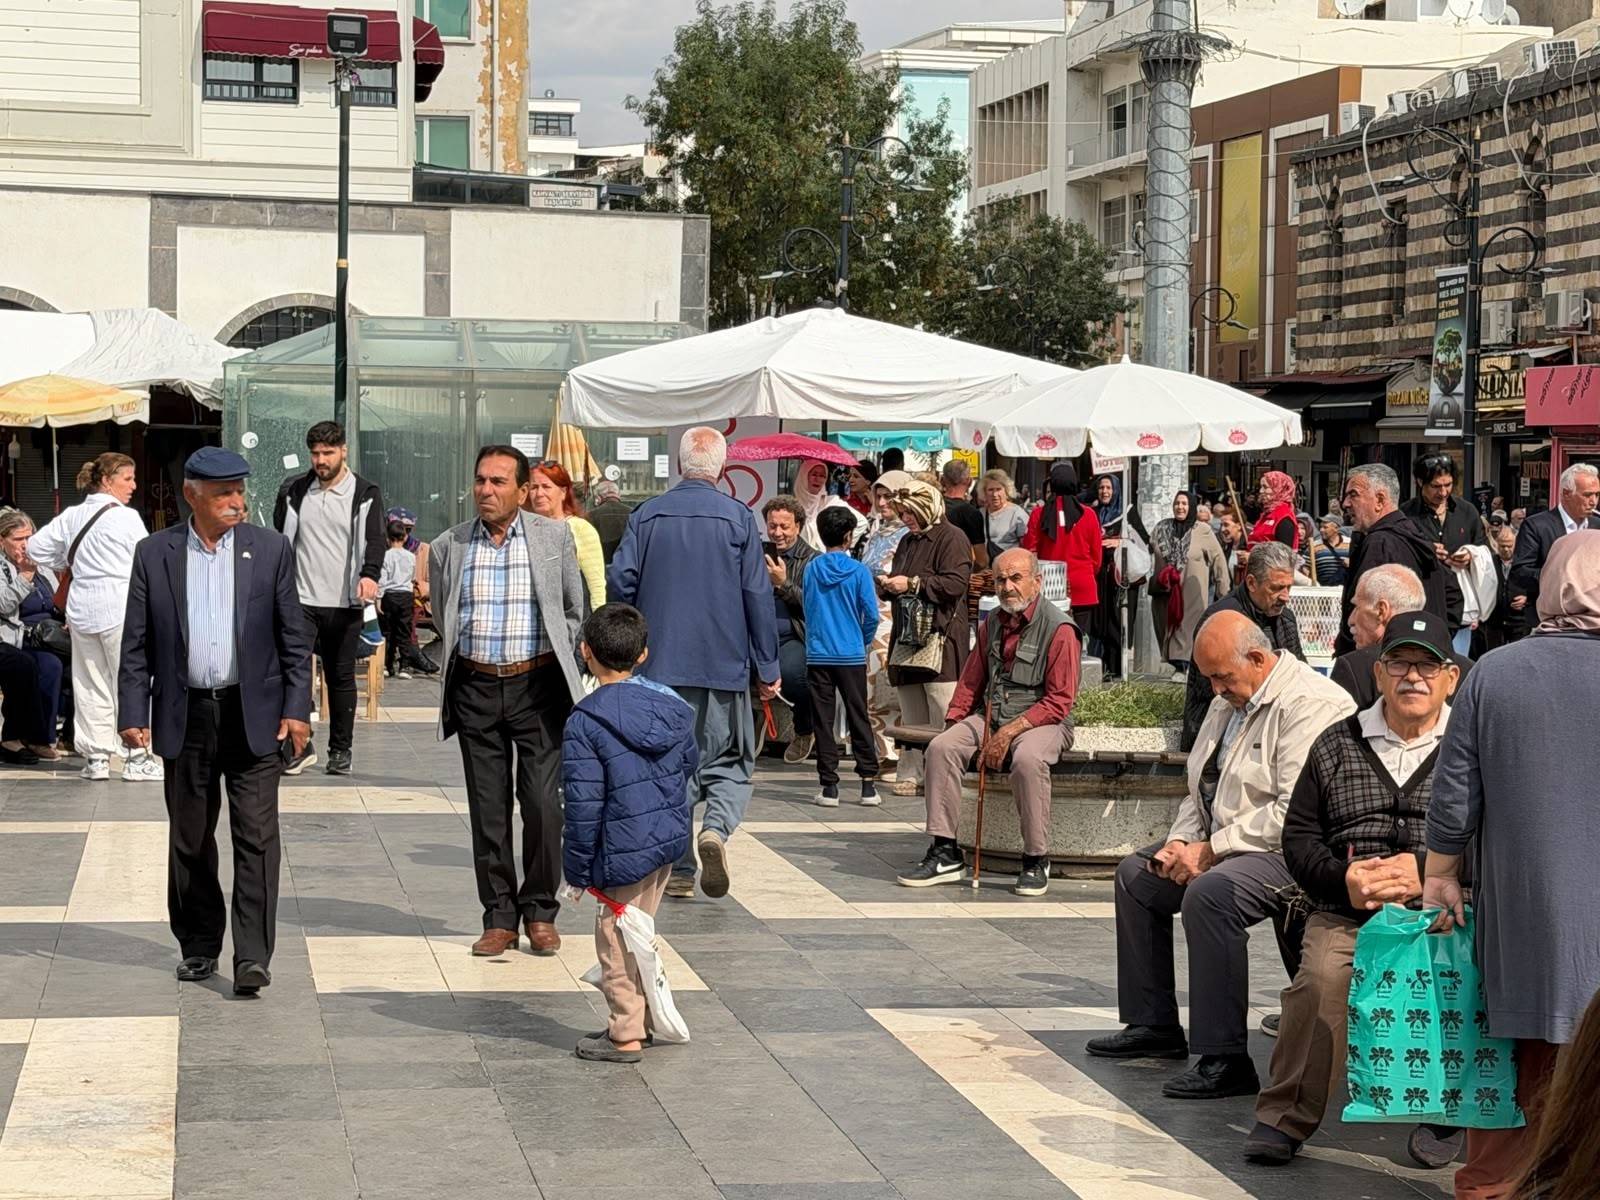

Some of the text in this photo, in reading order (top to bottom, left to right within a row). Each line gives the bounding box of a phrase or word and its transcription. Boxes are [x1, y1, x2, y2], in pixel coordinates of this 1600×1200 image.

[1493, 422, 1507, 433] SINCE
[861, 437, 885, 448] Golf
[926, 435, 945, 447] Golf
